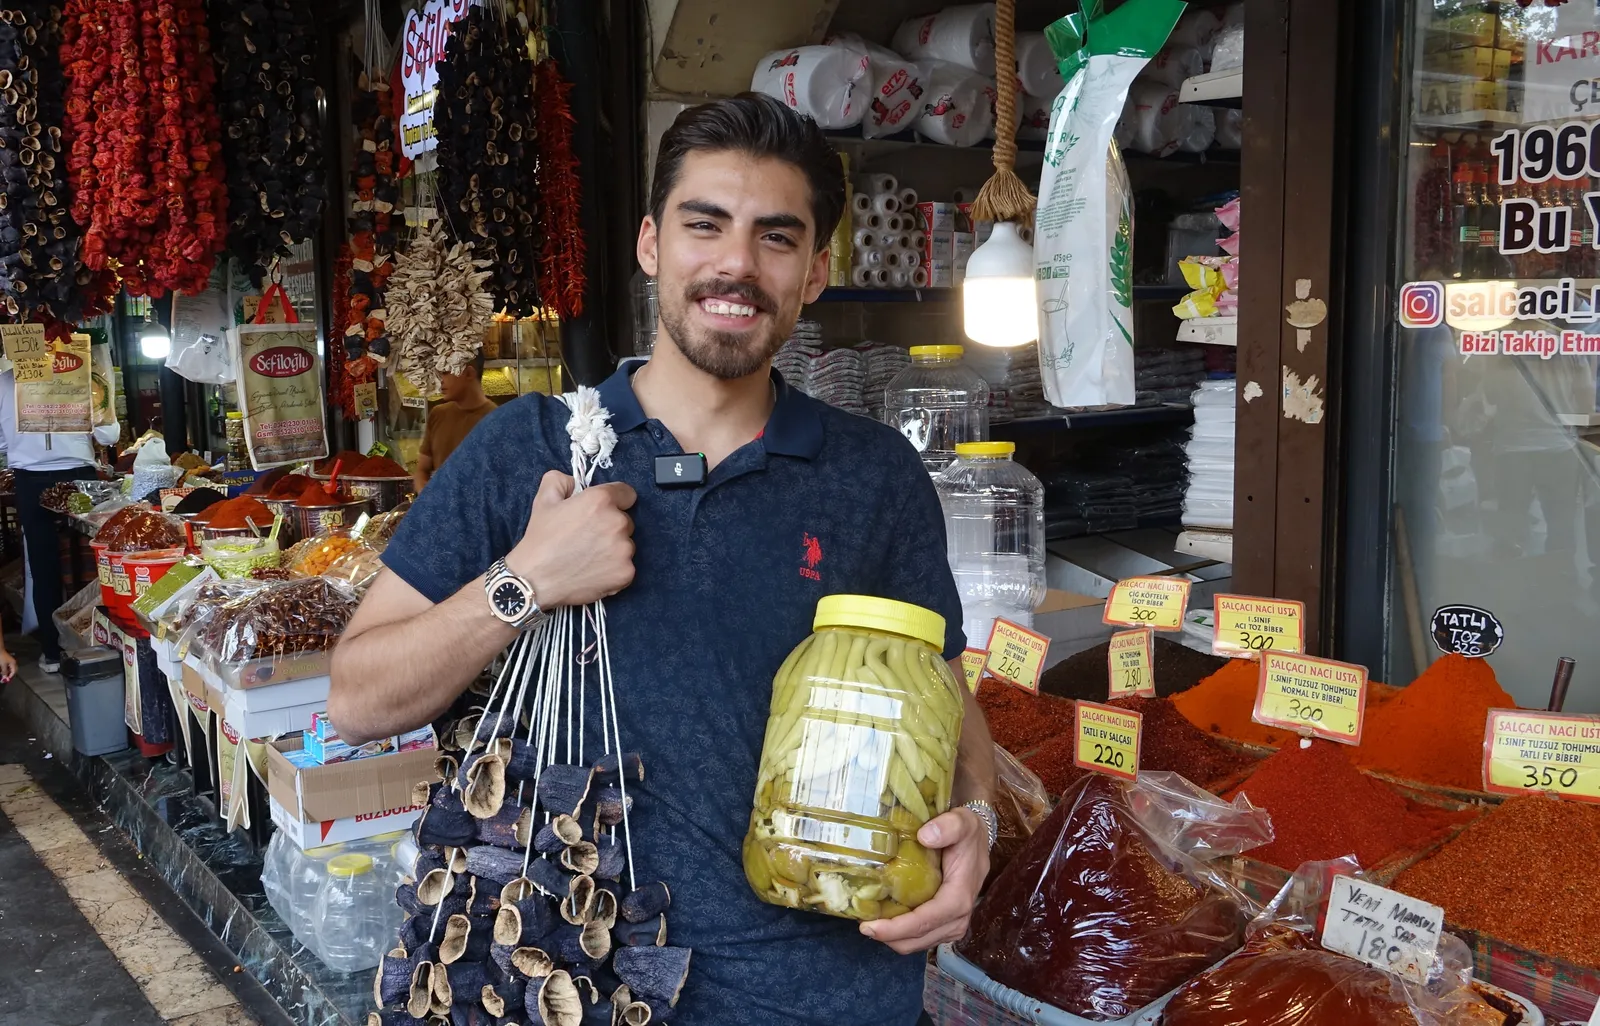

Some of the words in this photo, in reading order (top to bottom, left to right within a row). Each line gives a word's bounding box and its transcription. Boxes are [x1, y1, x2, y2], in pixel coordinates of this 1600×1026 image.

[788, 72, 797, 107] erze
[881, 69, 907, 96] erze
[1503, 202, 1567, 251] Bu
[1462, 334, 1496, 352] Bizi
[1503, 333, 1555, 357] Takip
[321, 512, 342, 525] 350
[1141, 592, 1169, 600] KÖFTELİK
[1167, 584, 1183, 592] USTA
[1146, 599, 1164, 607] BİBER
[1221, 601, 1253, 612] SALÇACI
[1255, 604, 1275, 614] NACİ
[1277, 607, 1297, 616] USTA
[1129, 606, 1157, 621] 300
[1440, 612, 1486, 631] TATLI
[1248, 623, 1262, 631] TOZ
[1263, 625, 1284, 634] BİBER
[1449, 628, 1482, 645] TOZ
[996, 625, 1018, 640] SALÇACI
[1017, 634, 1031, 646] NACİ
[1030, 640, 1043, 653] USTA
[1240, 631, 1274, 650] 300
[1452, 640, 1481, 656] 320
[997, 656, 1021, 680] 260
[1270, 659, 1307, 674] SALÇACI
[1310, 665, 1333, 680] NACİ
[1335, 671, 1358, 685] USTA
[1124, 668, 1142, 689] 280
[1294, 678, 1319, 690] TUZSUZ
[1320, 682, 1357, 698] TOHUMSUZ
[1281, 685, 1309, 698] NORMAL
[1311, 691, 1321, 700] EV
[1321, 693, 1343, 705] BİBERİ
[1081, 710, 1106, 723] SALÇACI
[1106, 715, 1121, 727] NACİ
[1122, 719, 1137, 730] USTA
[1286, 699, 1324, 722] 300
[1083, 726, 1099, 738] TATLI
[1099, 730, 1107, 739] EV
[1109, 732, 1132, 746] SALÇASI
[1499, 720, 1545, 736] SALÇACI
[1549, 724, 1577, 737] NACİ
[1528, 739, 1559, 751] TUZSUZ
[1093, 743, 1124, 769] 220
[1520, 749, 1540, 759] TATLI
[1542, 752, 1553, 761] EV
[1555, 753, 1582, 764] BİBERİ
[1522, 765, 1578, 788] 350
[1357, 929, 1402, 963] 180
